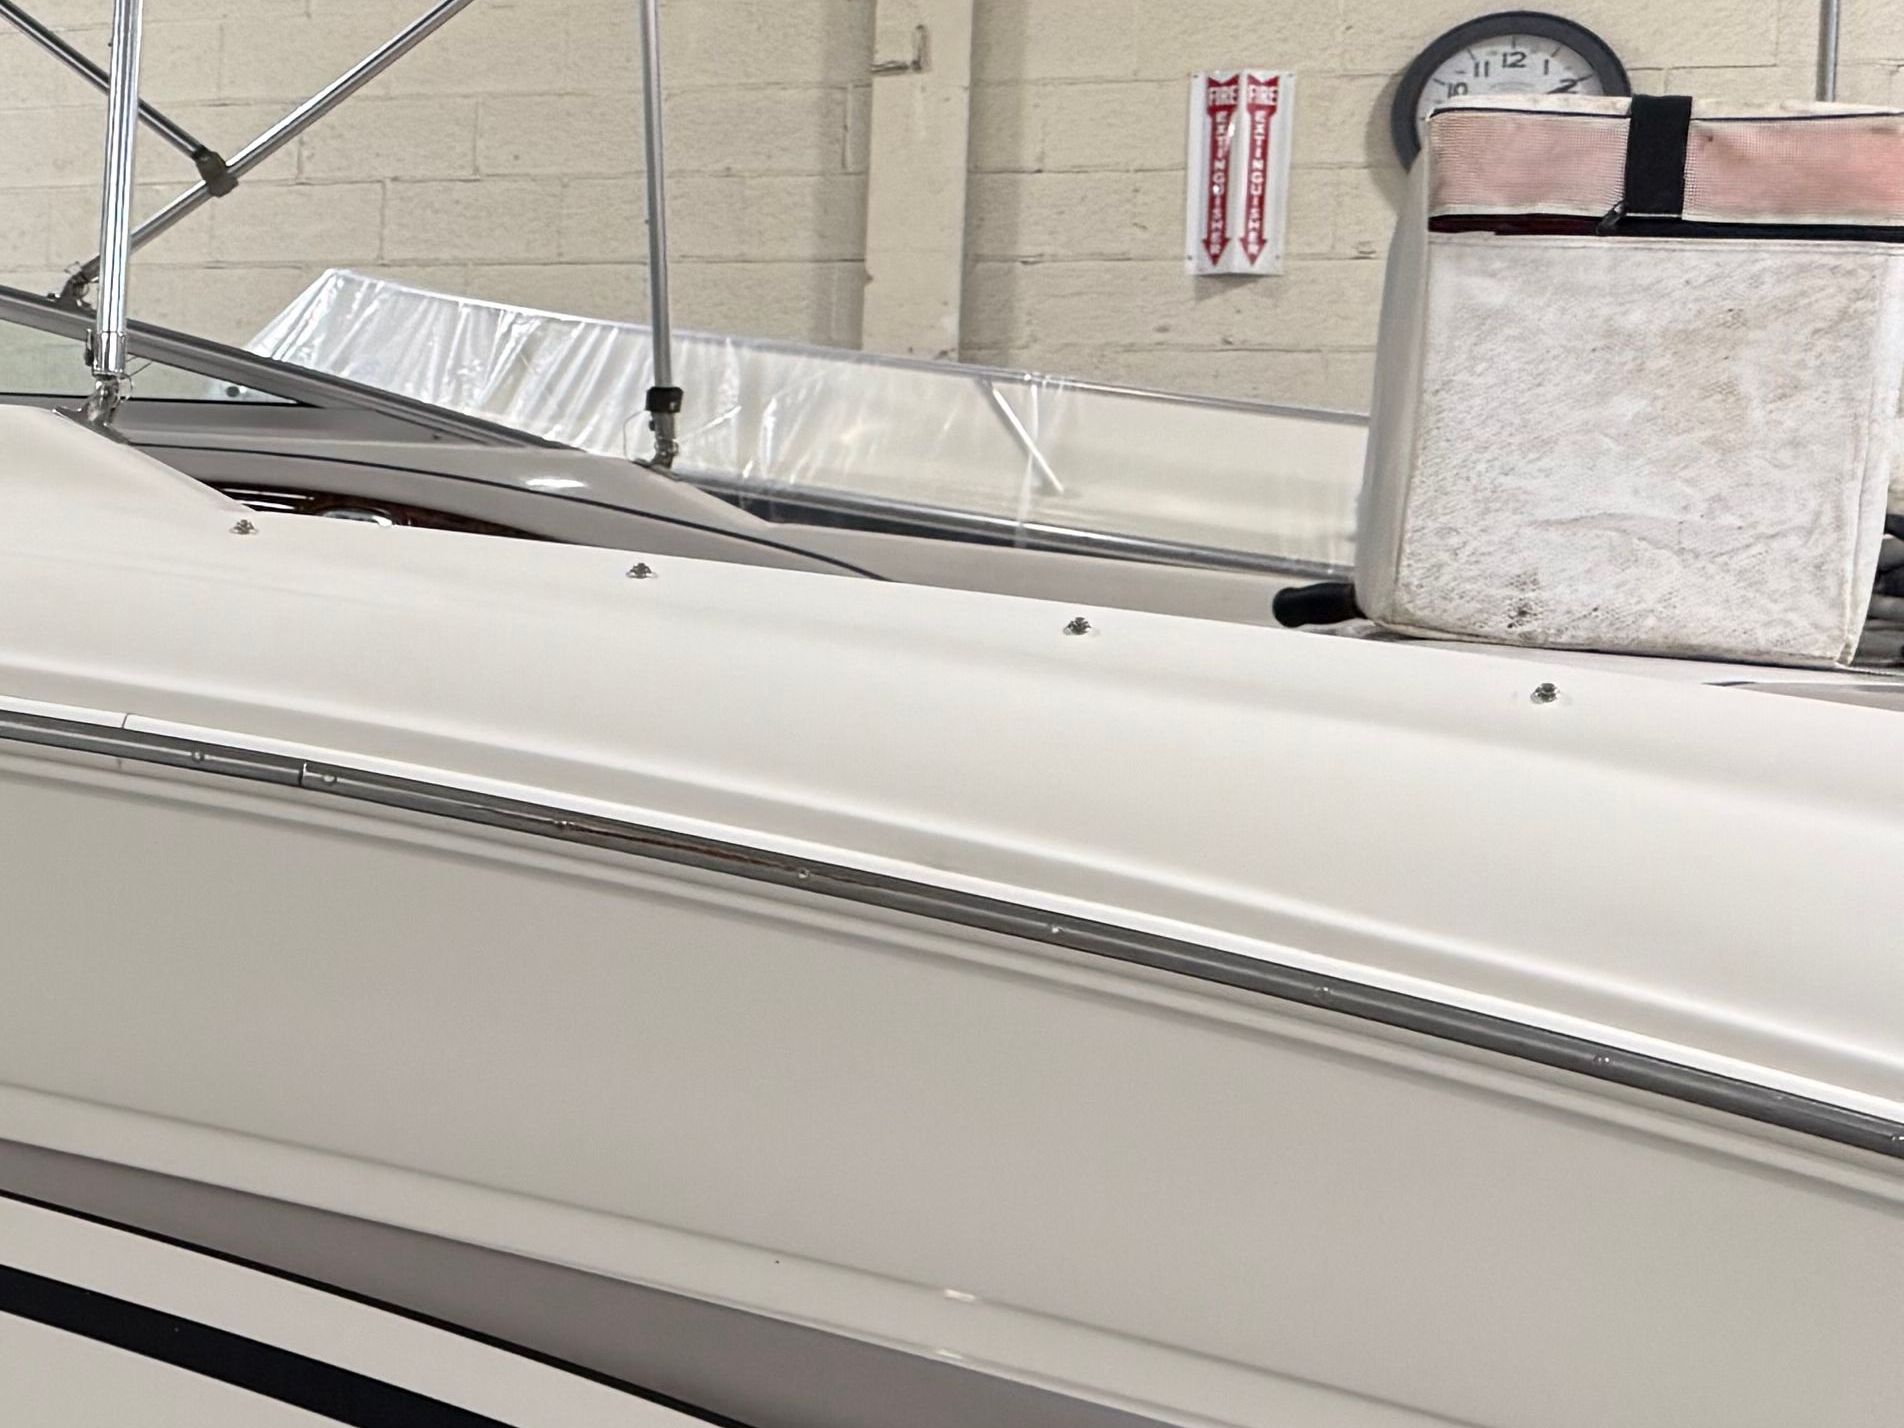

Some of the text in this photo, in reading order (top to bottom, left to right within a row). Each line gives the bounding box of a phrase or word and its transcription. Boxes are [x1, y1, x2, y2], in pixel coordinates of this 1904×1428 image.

[1473, 60, 1490, 78] 11
[1502, 51, 1527, 68] 12
[1543, 59, 1550, 75] 1
[1208, 85, 1239, 105] FIRE
[1247, 84, 1278, 105] FIRE
[1209, 110, 1229, 255] EXTINGUISHER
[1247, 110, 1267, 255] EXTINGUISHER
